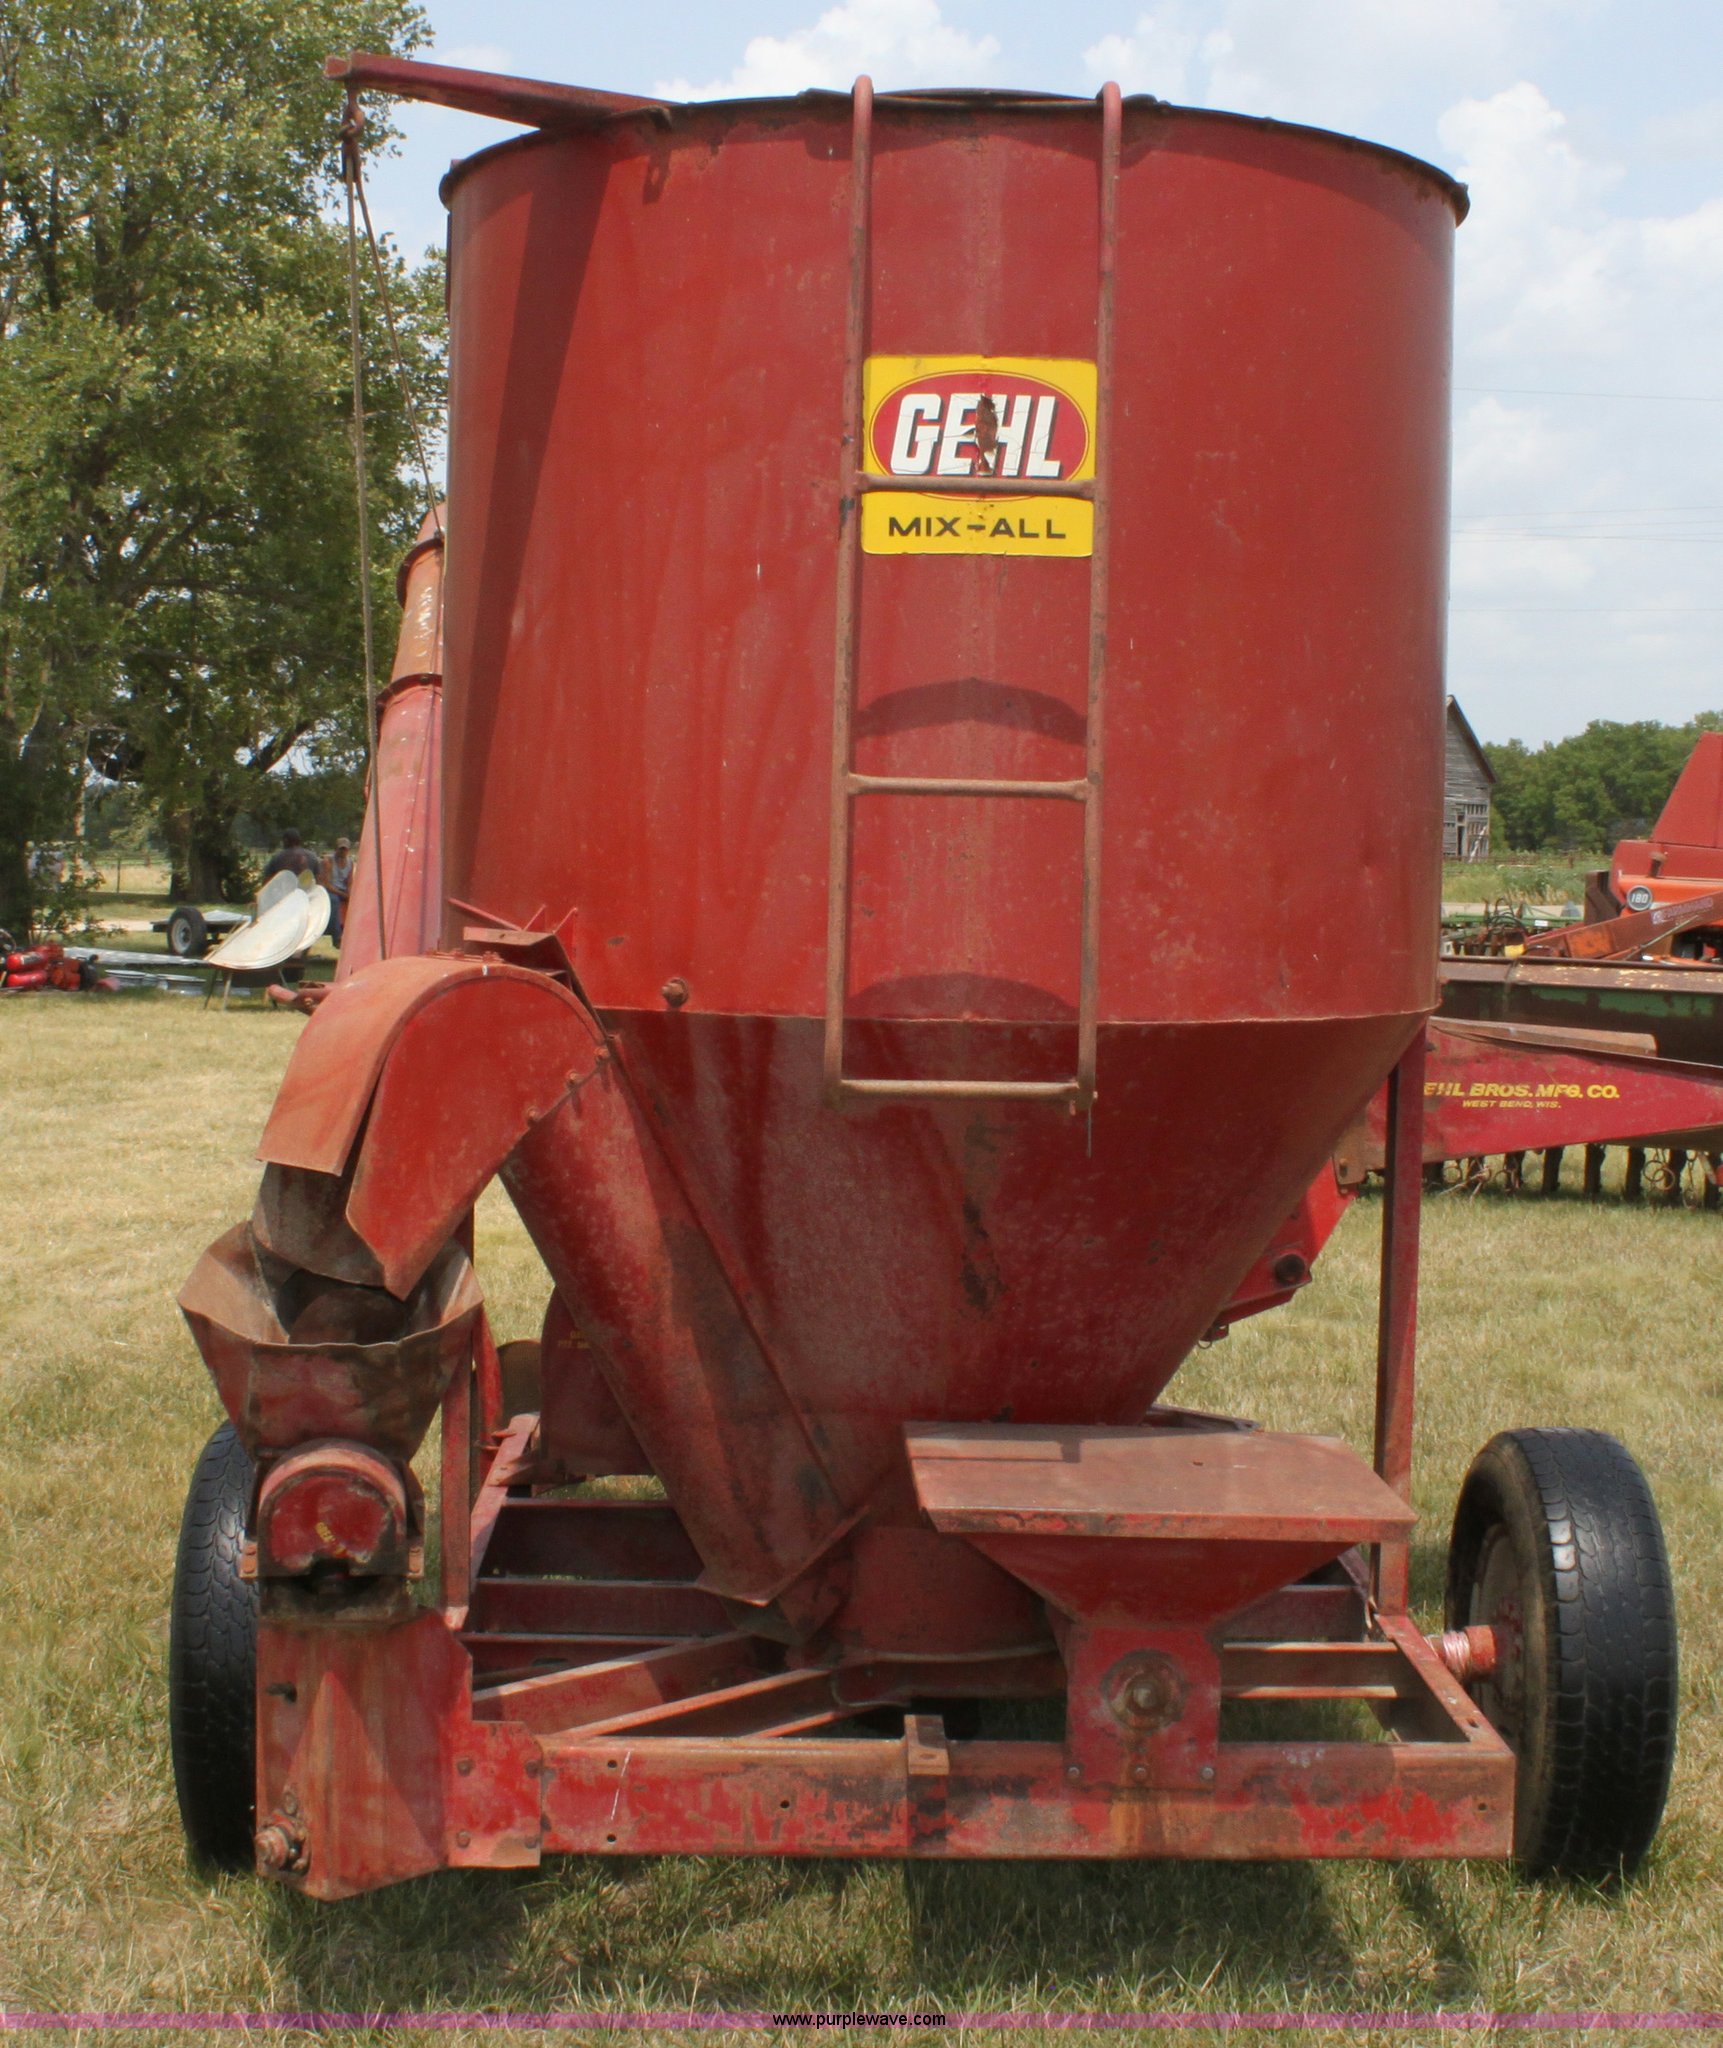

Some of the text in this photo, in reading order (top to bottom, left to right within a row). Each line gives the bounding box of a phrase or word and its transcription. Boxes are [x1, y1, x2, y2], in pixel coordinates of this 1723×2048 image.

[890, 392, 1061, 478] GEHL
[888, 516, 1067, 539] MIX-ALL
[1631, 893, 1649, 904] 180
[1423, 1082, 1621, 1099] EHL BROS. MFG. CO.
[1462, 1100, 1497, 1108] WEST
[1536, 1100, 1562, 1109] WIS.
